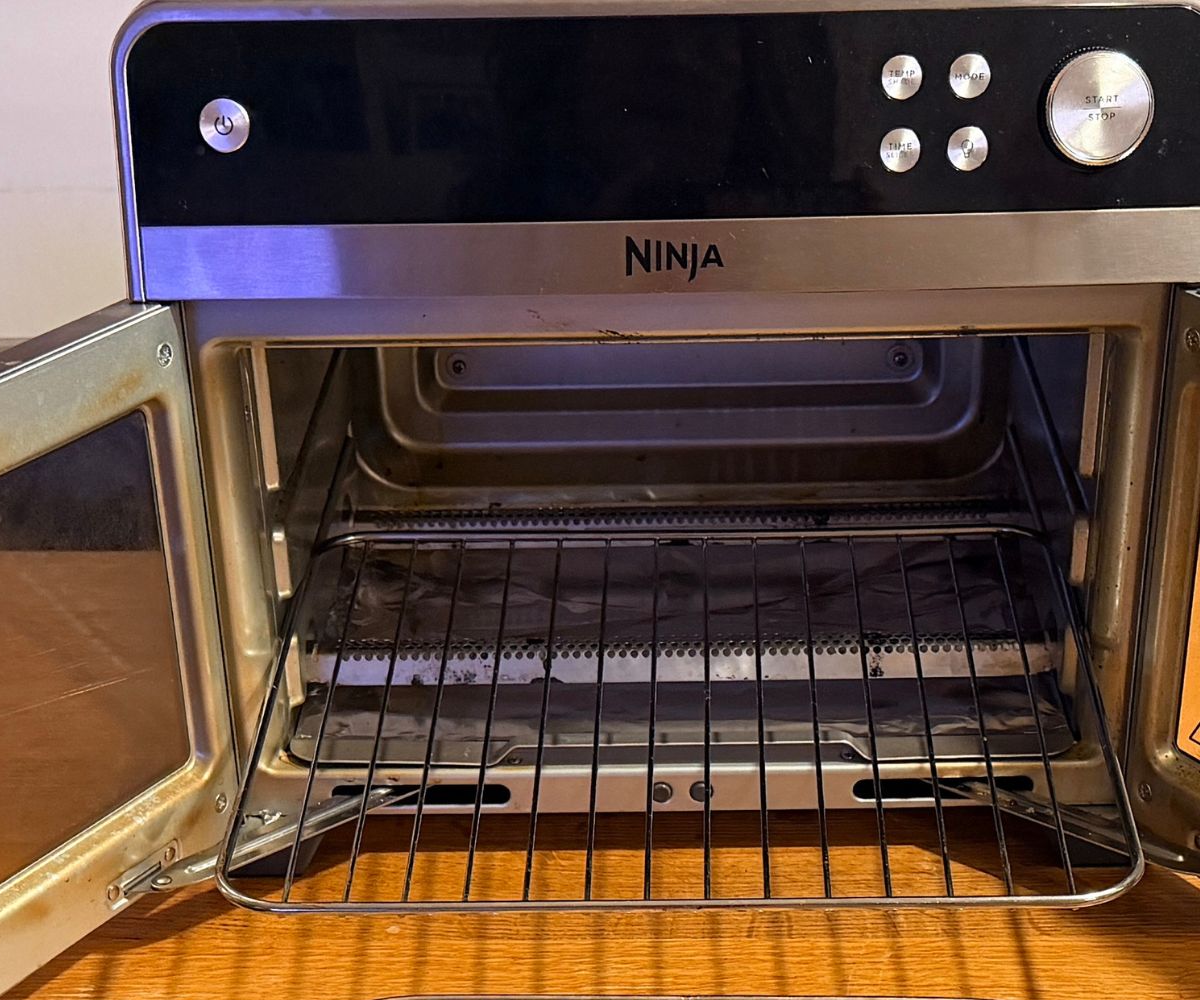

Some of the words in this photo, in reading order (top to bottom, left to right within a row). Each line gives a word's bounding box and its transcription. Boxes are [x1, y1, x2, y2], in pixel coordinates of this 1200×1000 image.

[954, 72, 985, 81] MODE
[1085, 94, 1119, 104] START
[1088, 112, 1116, 121] STOP
[888, 142, 913, 151] TIME
[625, 235, 725, 283] NINJA
